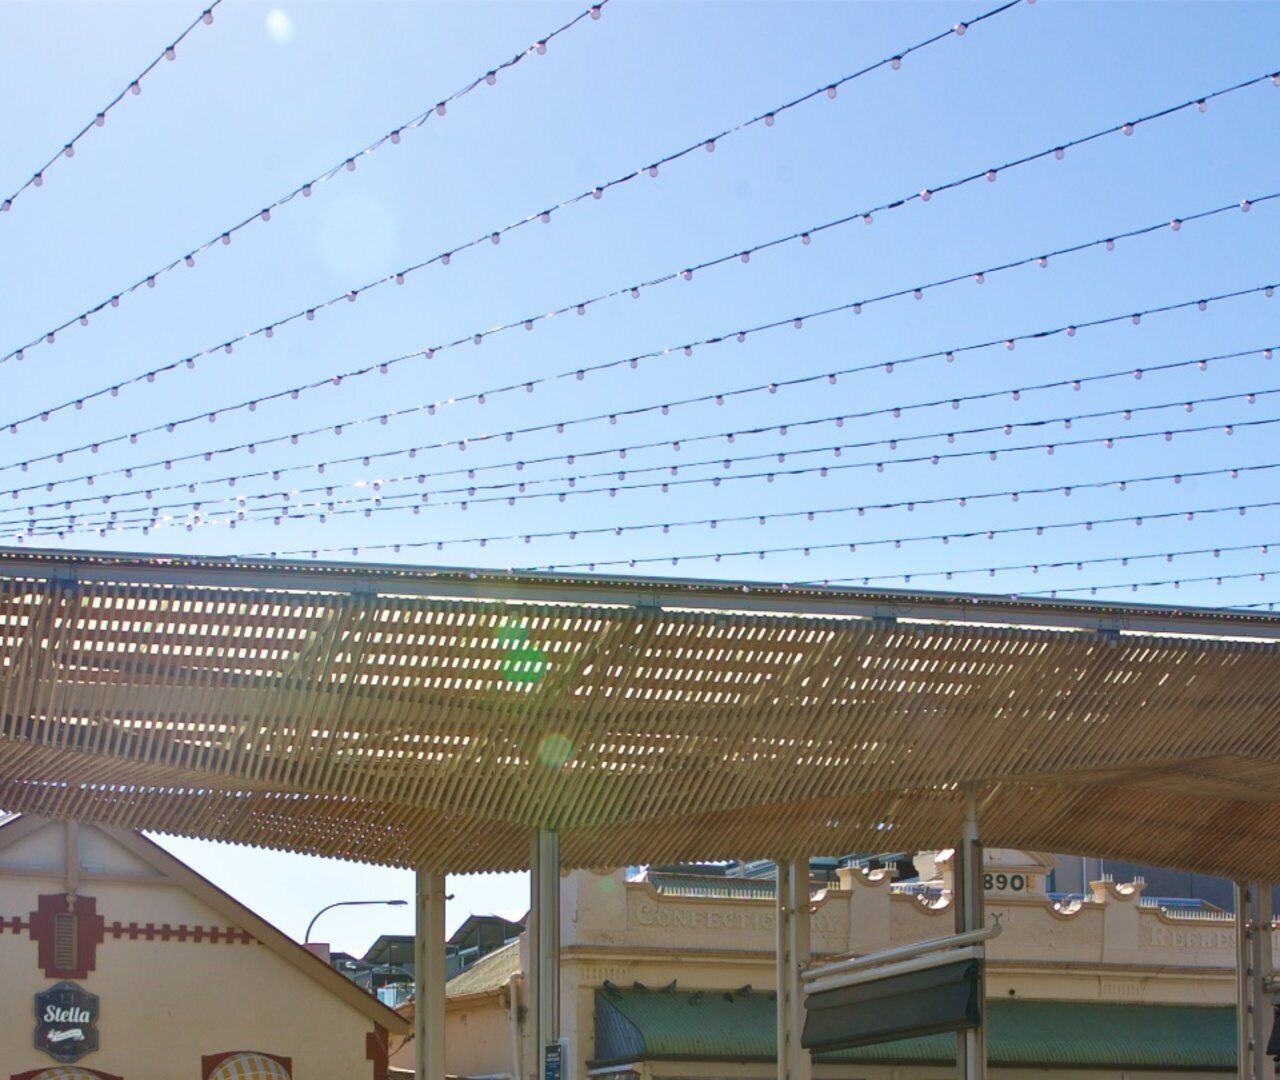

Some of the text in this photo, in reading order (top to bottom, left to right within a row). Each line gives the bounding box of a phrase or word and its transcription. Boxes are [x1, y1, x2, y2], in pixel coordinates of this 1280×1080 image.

[983, 873, 1024, 891] 890
[635, 902, 839, 932] CONFECTIORY
[43, 1004, 90, 1023] Stella
